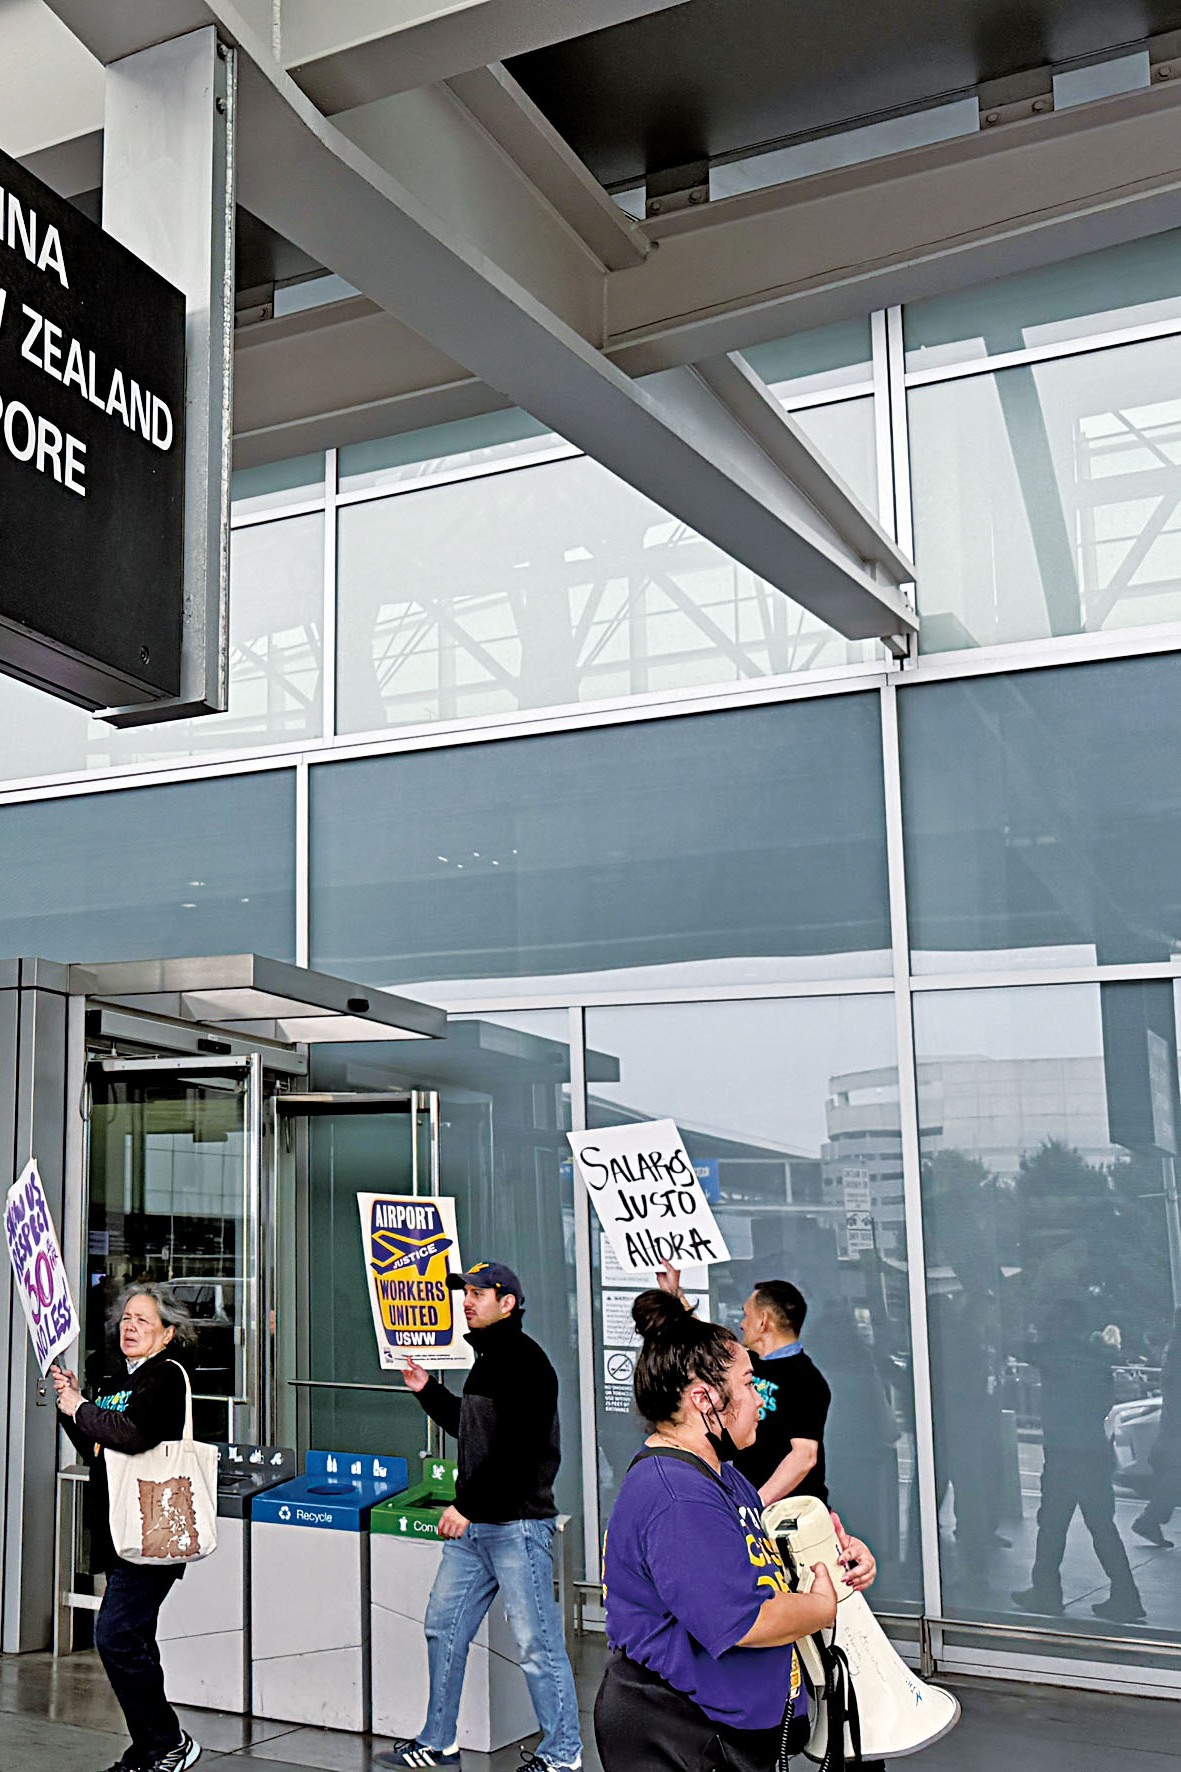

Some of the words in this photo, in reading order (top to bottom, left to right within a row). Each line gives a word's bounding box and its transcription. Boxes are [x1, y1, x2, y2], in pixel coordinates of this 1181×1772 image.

[21, 303, 174, 452] ZEALAND
[375, 1204, 435, 1230] AIRPORT
[614, 1189, 697, 1222] JUSTO
[392, 1243, 438, 1269] JUSTICE
[625, 1227, 718, 1267] AHORA
[24, 1250, 54, 1325] 30
[380, 1281, 446, 1302] WORKERS
[389, 1305, 438, 1326] UNITED
[395, 1331, 436, 1346] USWW
[296, 1510, 333, 1523] Recycle
